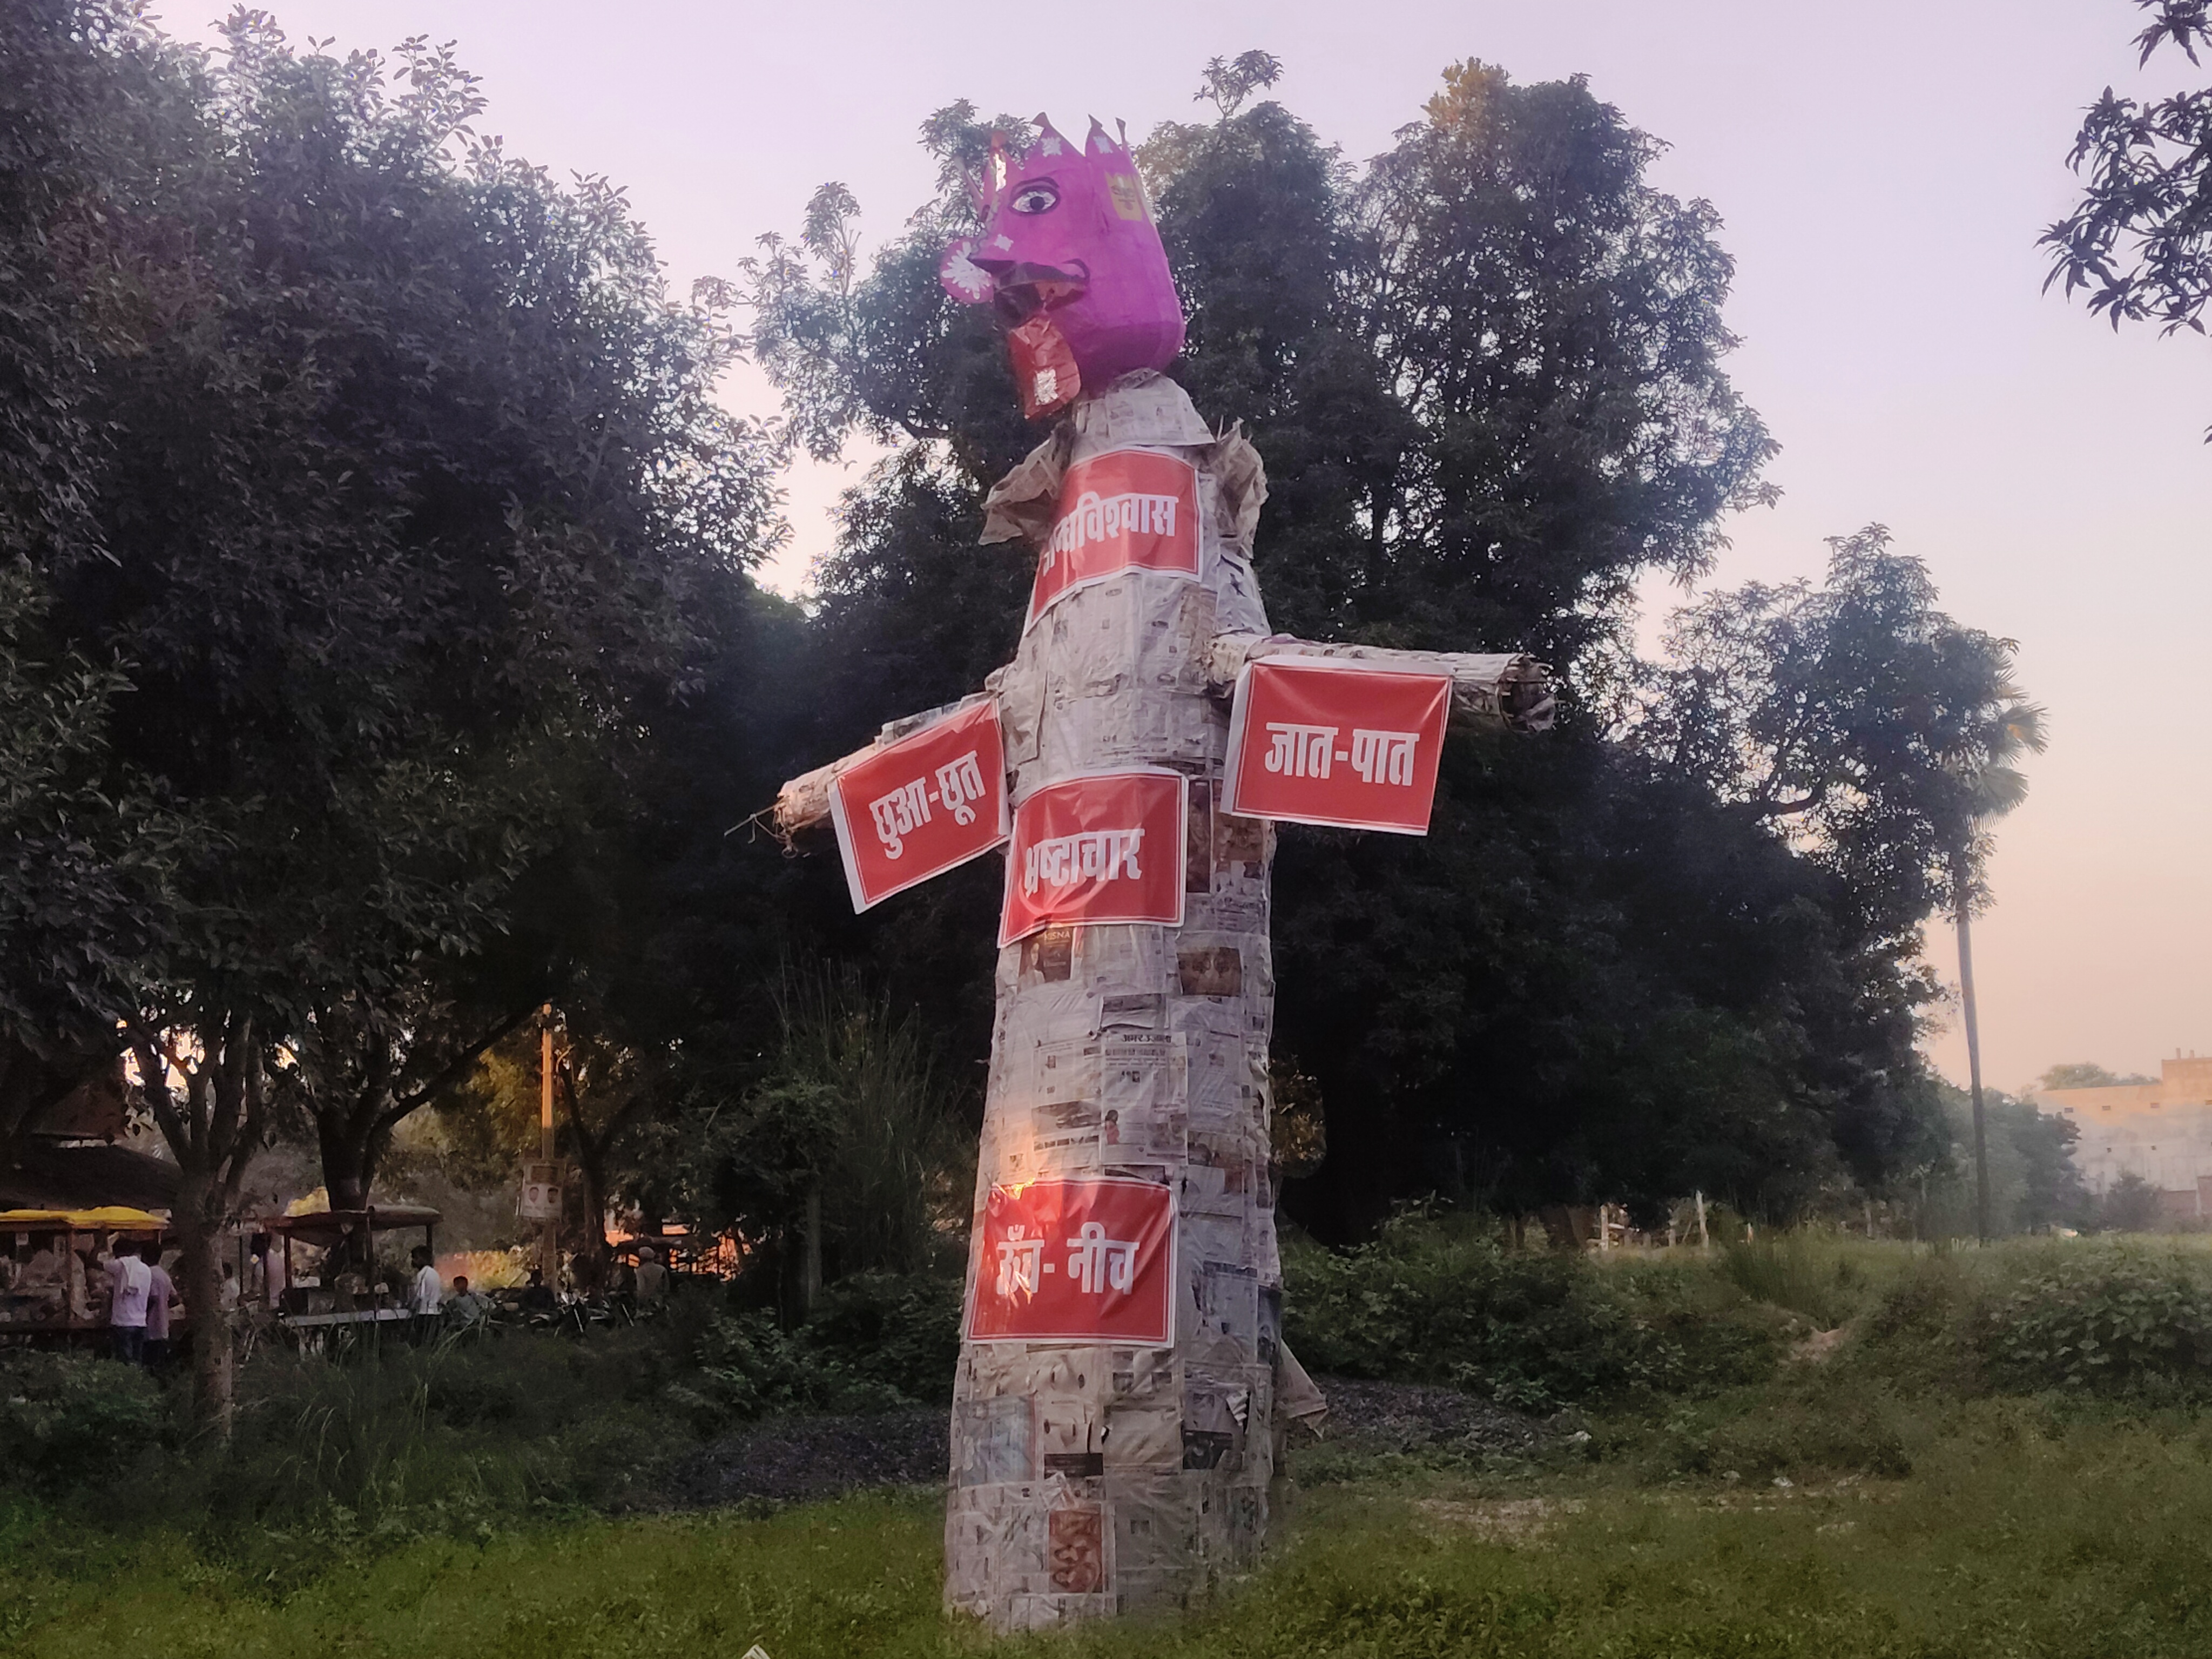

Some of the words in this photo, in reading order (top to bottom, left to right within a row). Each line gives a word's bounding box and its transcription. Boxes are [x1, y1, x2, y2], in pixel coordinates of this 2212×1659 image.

[1265, 722, 1420, 786] जात-पात
[868, 750, 986, 860] छुआ-छूत
[1024, 828, 1145, 898] भ्रष्टाचार
